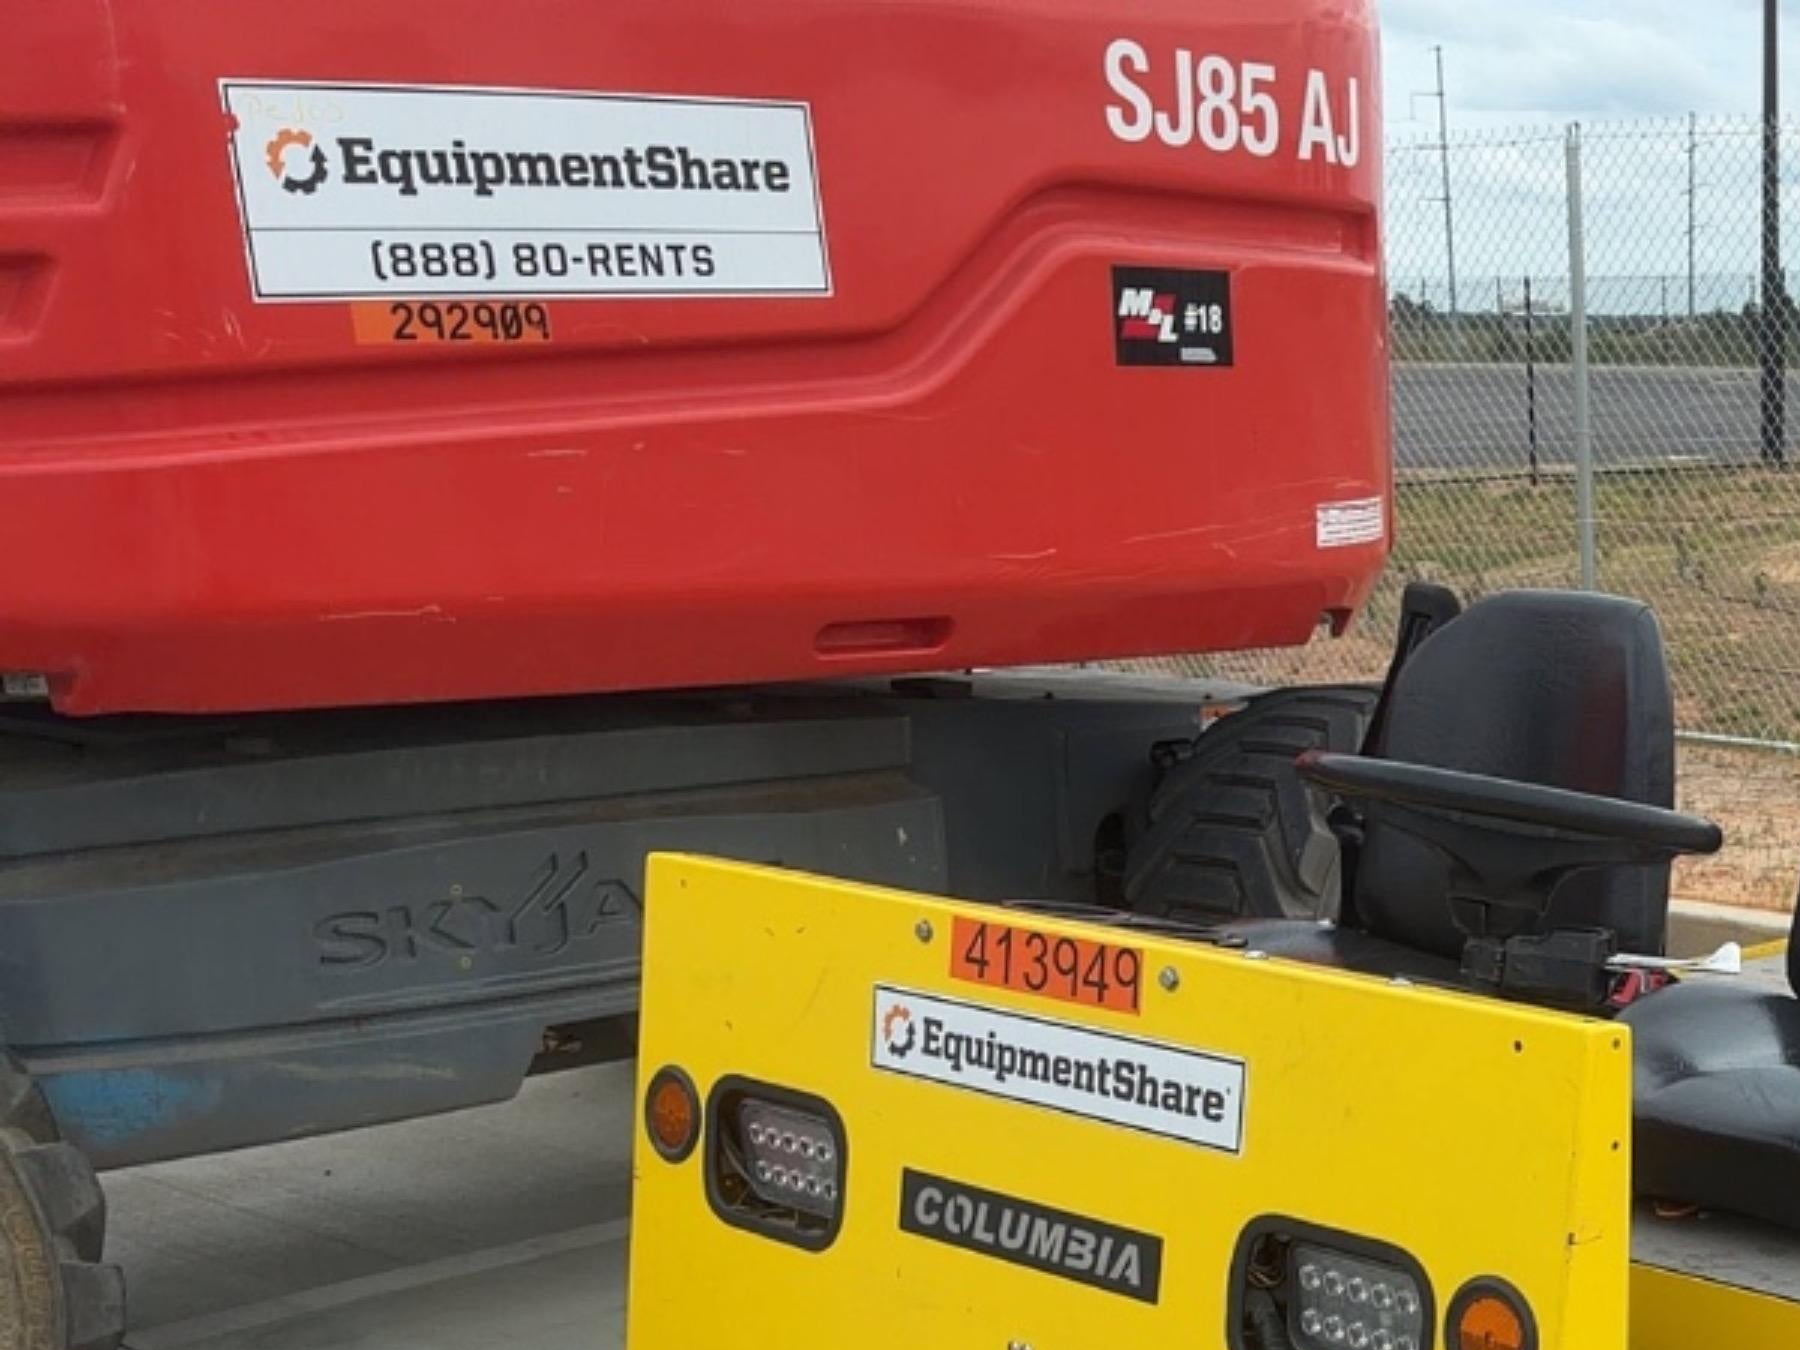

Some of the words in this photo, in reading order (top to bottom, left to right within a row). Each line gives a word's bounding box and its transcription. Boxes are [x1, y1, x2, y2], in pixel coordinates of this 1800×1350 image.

[1105, 38, 1280, 157] SJ85
[1297, 68, 1359, 169] AJ
[336, 137, 791, 197] EquipmentShare
[371, 239, 496, 281] (888)
[512, 243, 716, 279] 80-RENTS
[390, 302, 550, 342] 292909
[313, 850, 644, 966] SKYJA
[964, 922, 1139, 1010] 413949
[920, 1016, 1226, 1124] EquipmentShare
[913, 1186, 1143, 1287] COLUMBIA
